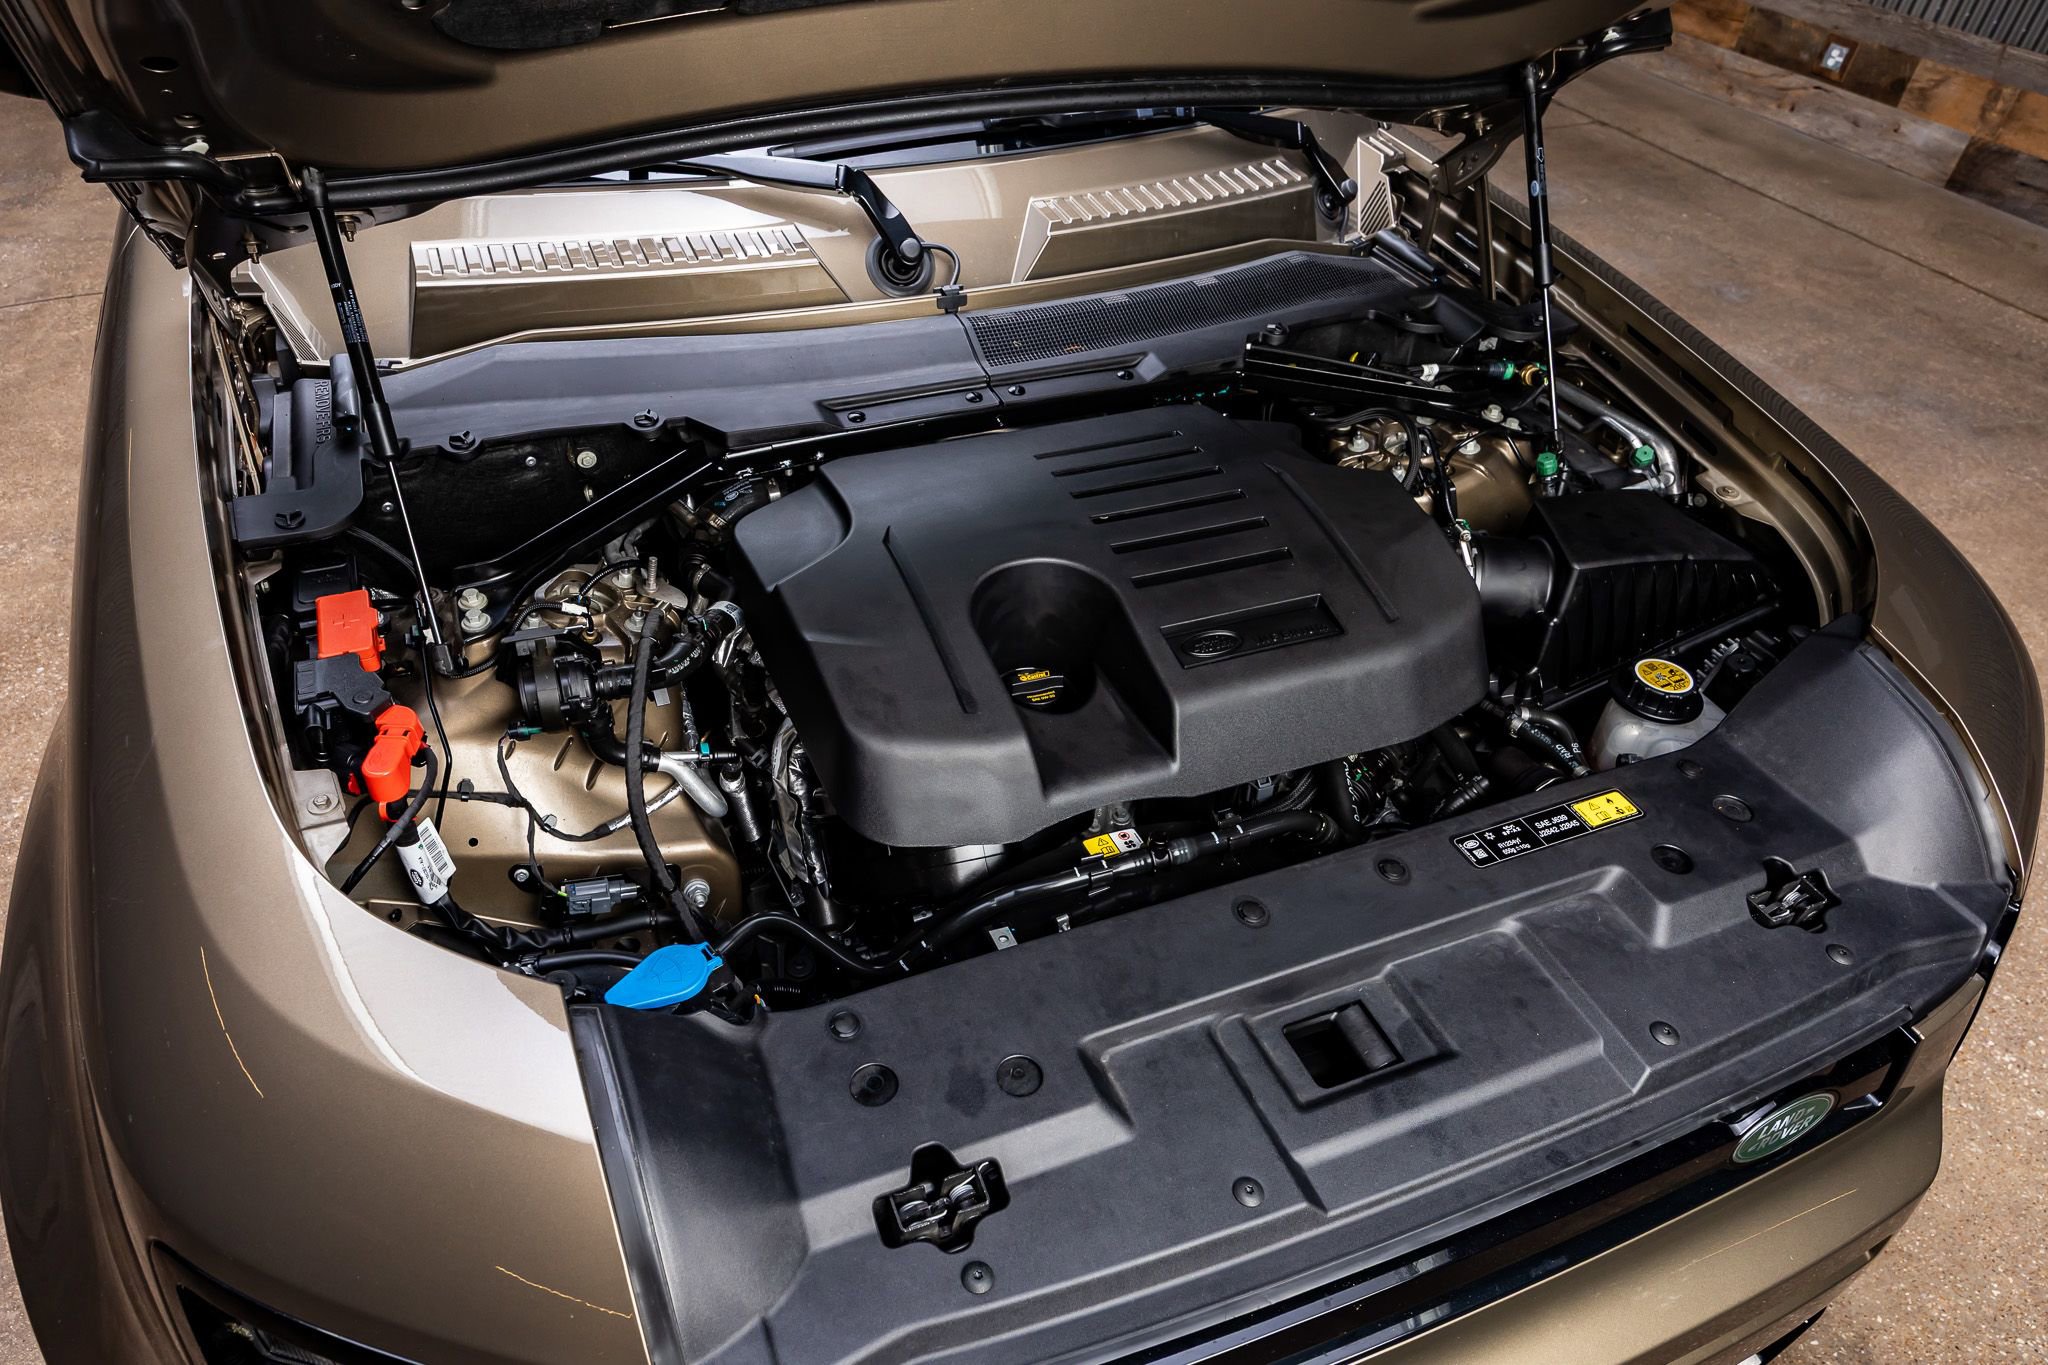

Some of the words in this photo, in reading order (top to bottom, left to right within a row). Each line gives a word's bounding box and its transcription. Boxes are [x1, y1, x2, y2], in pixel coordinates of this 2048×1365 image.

[315, 380, 331, 420] REMOVE
[1555, 744, 1573, 759] RAD
[1534, 819, 1552, 829] SAE
[1757, 1114, 1814, 1151] ROVER
[1758, 1108, 1806, 1140] LAND
